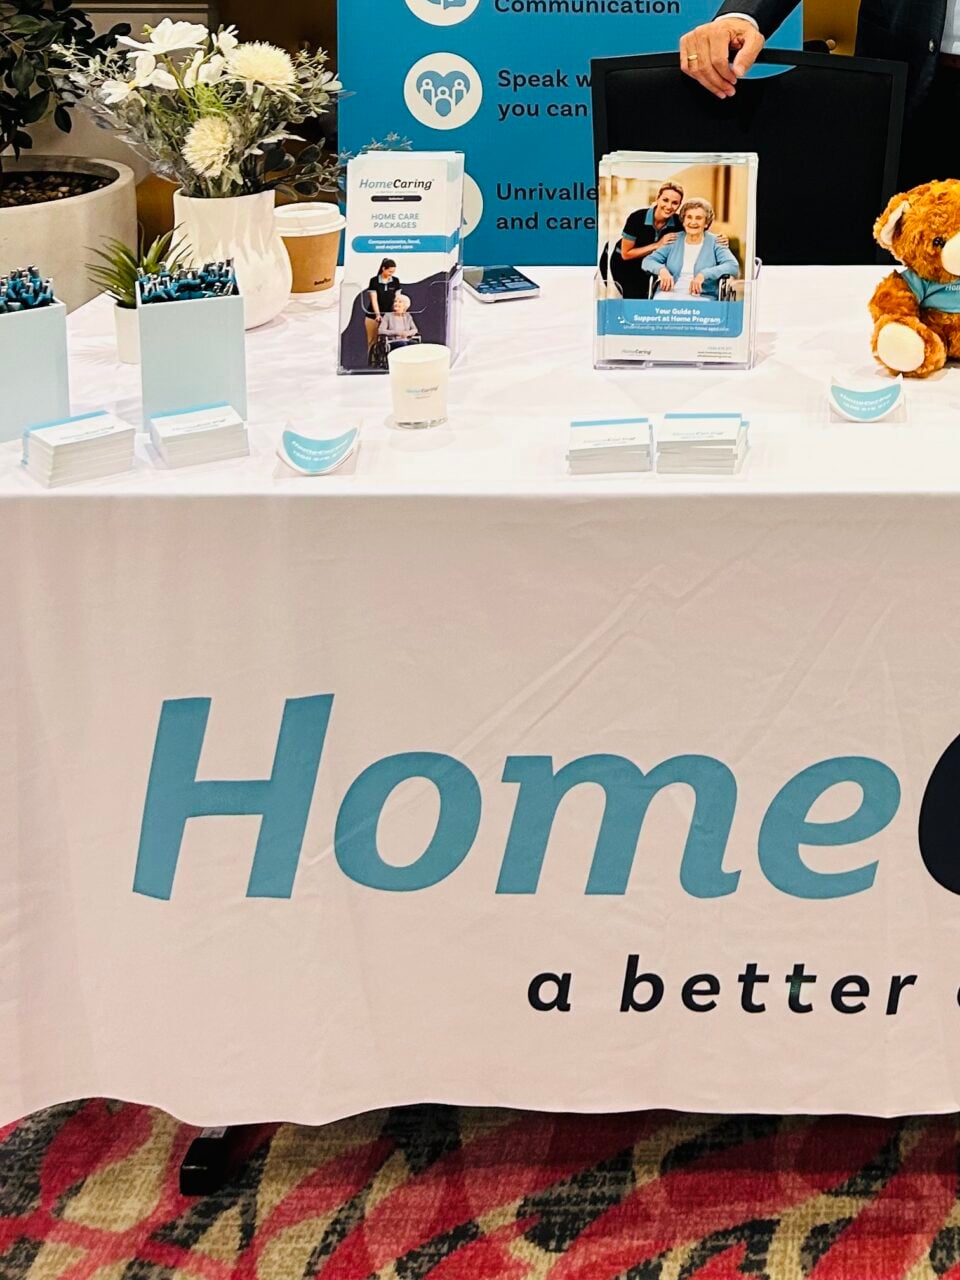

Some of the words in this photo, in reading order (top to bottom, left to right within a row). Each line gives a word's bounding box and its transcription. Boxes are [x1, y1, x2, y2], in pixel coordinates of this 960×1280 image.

[498, 69, 568, 92] Speak
[498, 103, 539, 120] you
[547, 103, 587, 117] can
[496, 182, 597, 200] Unrivalle
[496, 212, 538, 229] and
[546, 217, 596, 230] care
[692, 316, 720, 324] Program
[527, 971, 572, 1012] a
[620, 954, 917, 1015] better
